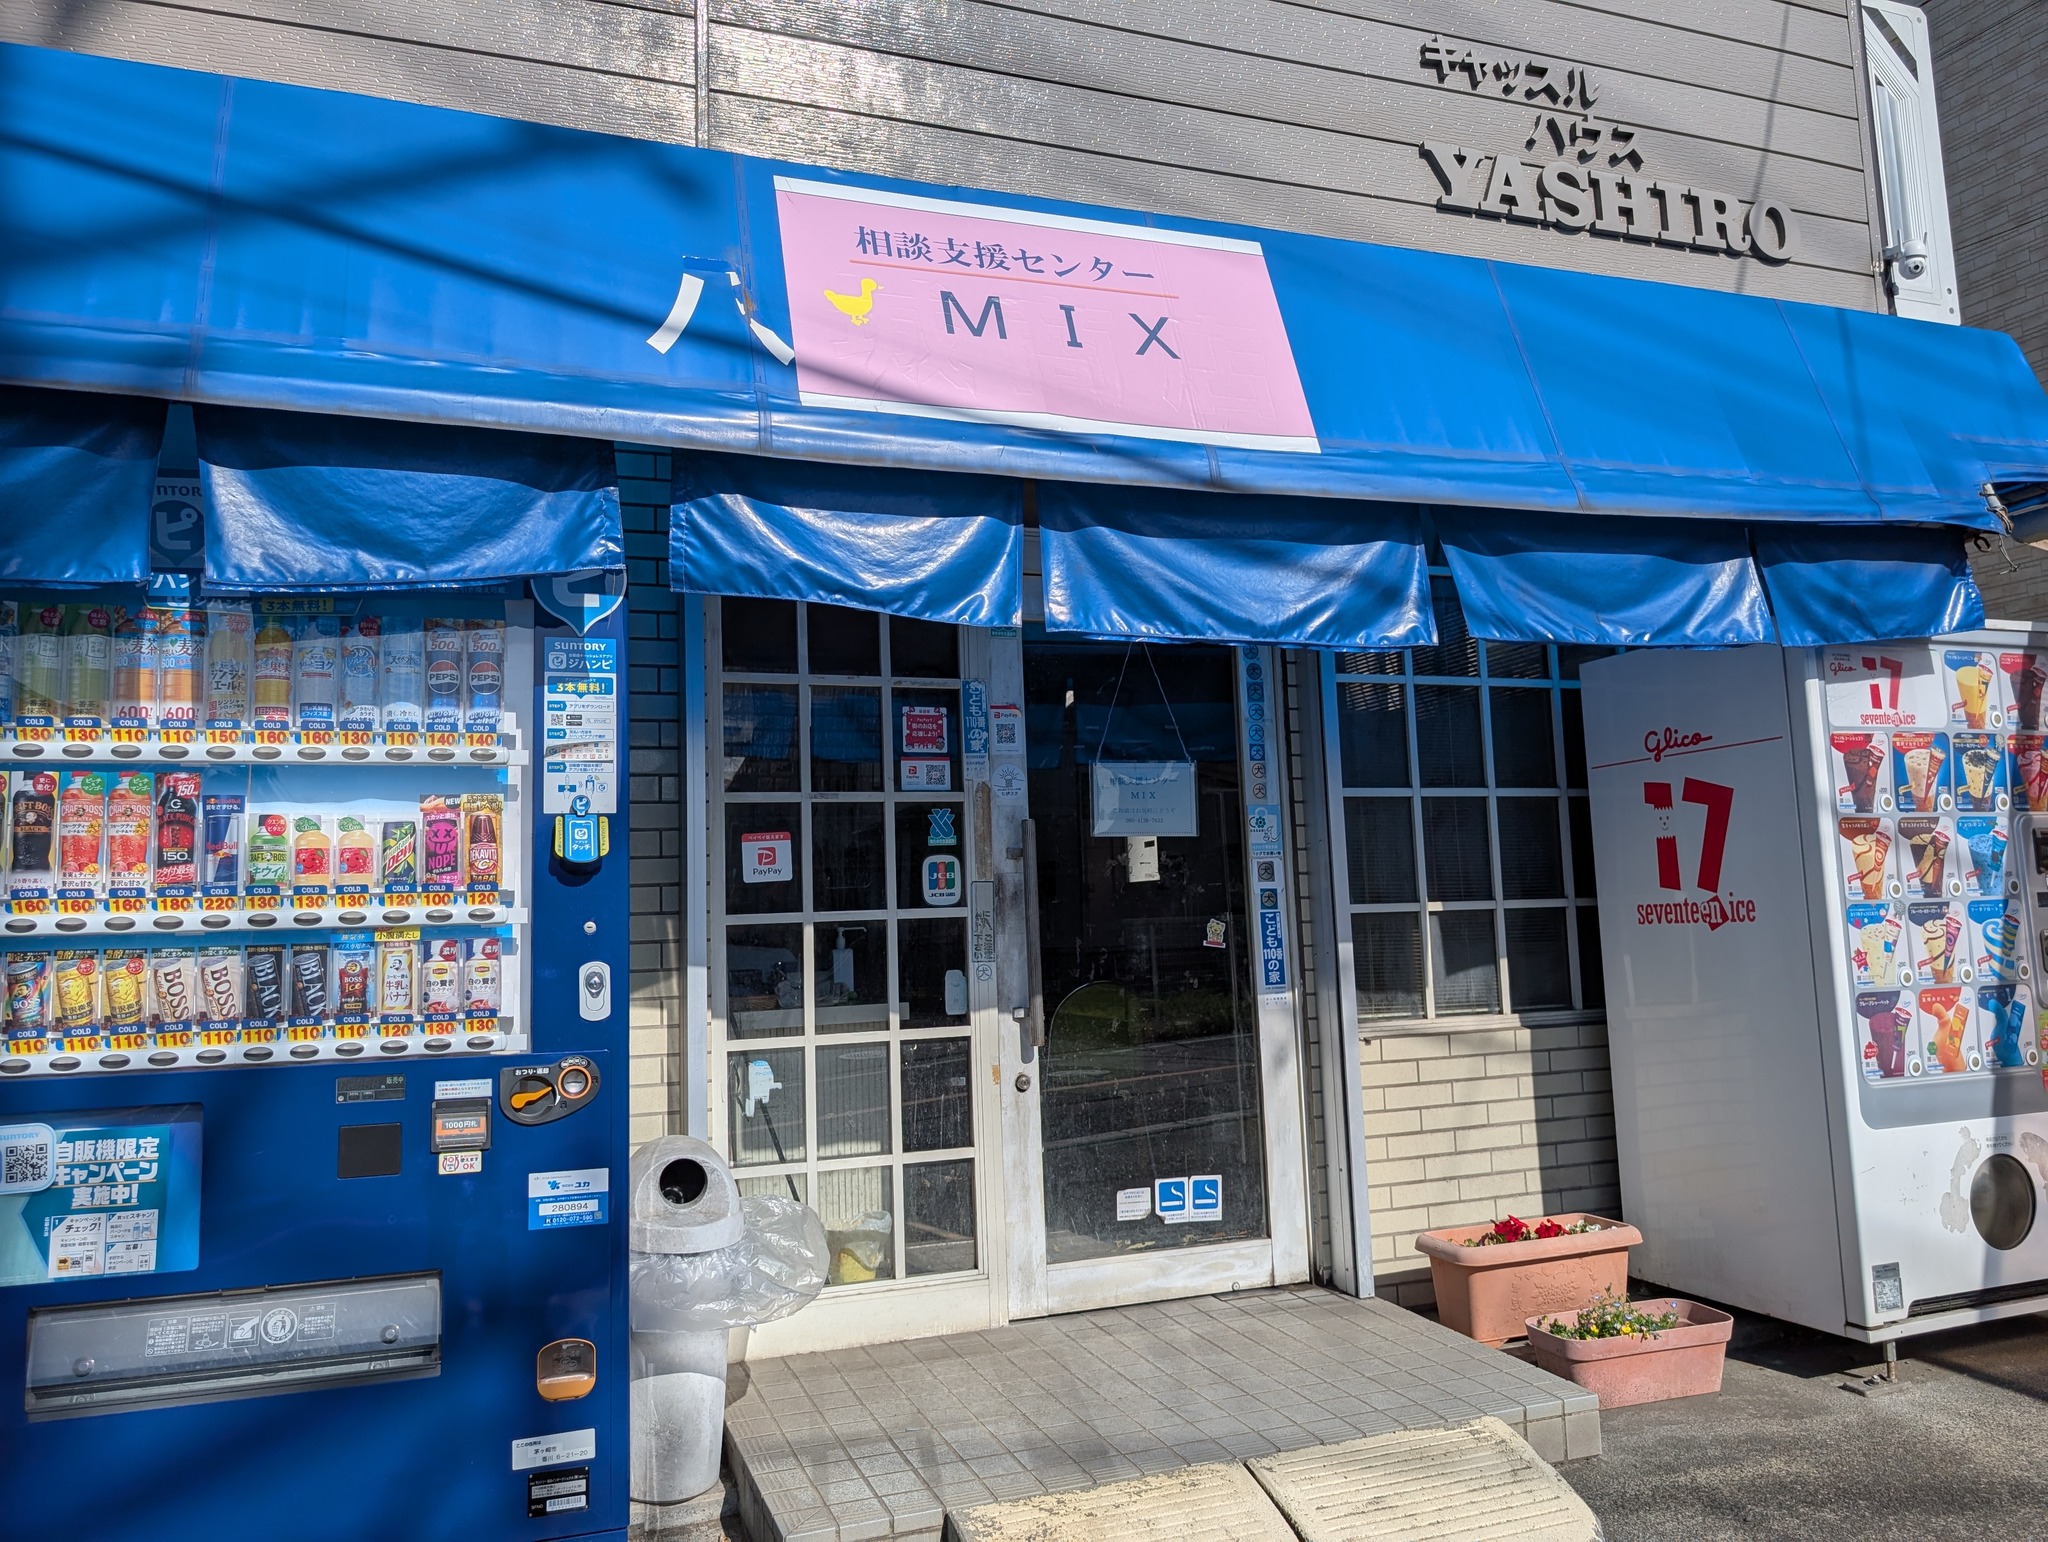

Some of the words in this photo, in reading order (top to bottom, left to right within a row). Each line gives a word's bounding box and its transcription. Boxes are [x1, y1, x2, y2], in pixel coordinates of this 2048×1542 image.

[1419, 34, 1599, 110] キャッスル
[1525, 113, 1645, 171] ハウス
[1419, 140, 1801, 266] YASHIRO
[855, 225, 1155, 283] 相談支援センター
[178, 638, 204, 657] 麦茶
[554, 642, 607, 651] SUNTORY
[568, 659, 613, 670] ジハンピ
[1830, 662, 1856, 676] Glico
[429, 673, 459, 682] PEPSI
[556, 683, 605, 693] 3本無料!
[25, 718, 45, 726] COLD
[1860, 712, 1902, 725] seventeen
[1903, 711, 1916, 725] ice
[473, 724, 490, 732] COLD
[1644, 727, 1713, 762] Glico
[1131, 791, 1156, 799] MIX
[446, 798, 460, 806] NEW
[84, 805, 104, 816] BOSS
[132, 805, 152, 816] BOSS
[223, 842, 238, 850] Bull
[428, 854, 456, 870] NOPE
[752, 867, 782, 876] PayPay
[165, 888, 185, 896] COLD
[210, 888, 230, 896] COLD
[428, 884, 446, 892] COLD
[66, 890, 86, 898] COLD
[1637, 897, 1723, 925] seventeen
[1729, 891, 1756, 923] ice
[376, 931, 419, 940] 小腹満たし
[1264, 913, 1283, 983] こども110番の家
[386, 980, 409, 991] 牛乳と
[426, 979, 455, 988] 白の贅沢
[468, 977, 496, 986] 白の贅沢
[164, 967, 190, 1020] BOSS
[211, 965, 237, 1019] BOSS
[254, 960, 282, 1018] BLACK
[300, 959, 327, 1017] BLACK
[385, 991, 410, 1002] バナナ
[17, 1030, 38, 1038] COLD
[515, 1068, 550, 1076] おつり・返却
[445, 1121, 478, 1130] 1000円札
[56, 1137, 159, 1163] 自販機限定
[56, 1162, 158, 1187] キャンペーン
[72, 1184, 139, 1207] 実施中!
[552, 1202, 588, 1212] 280894
[65, 1223, 102, 1233] チェック!
